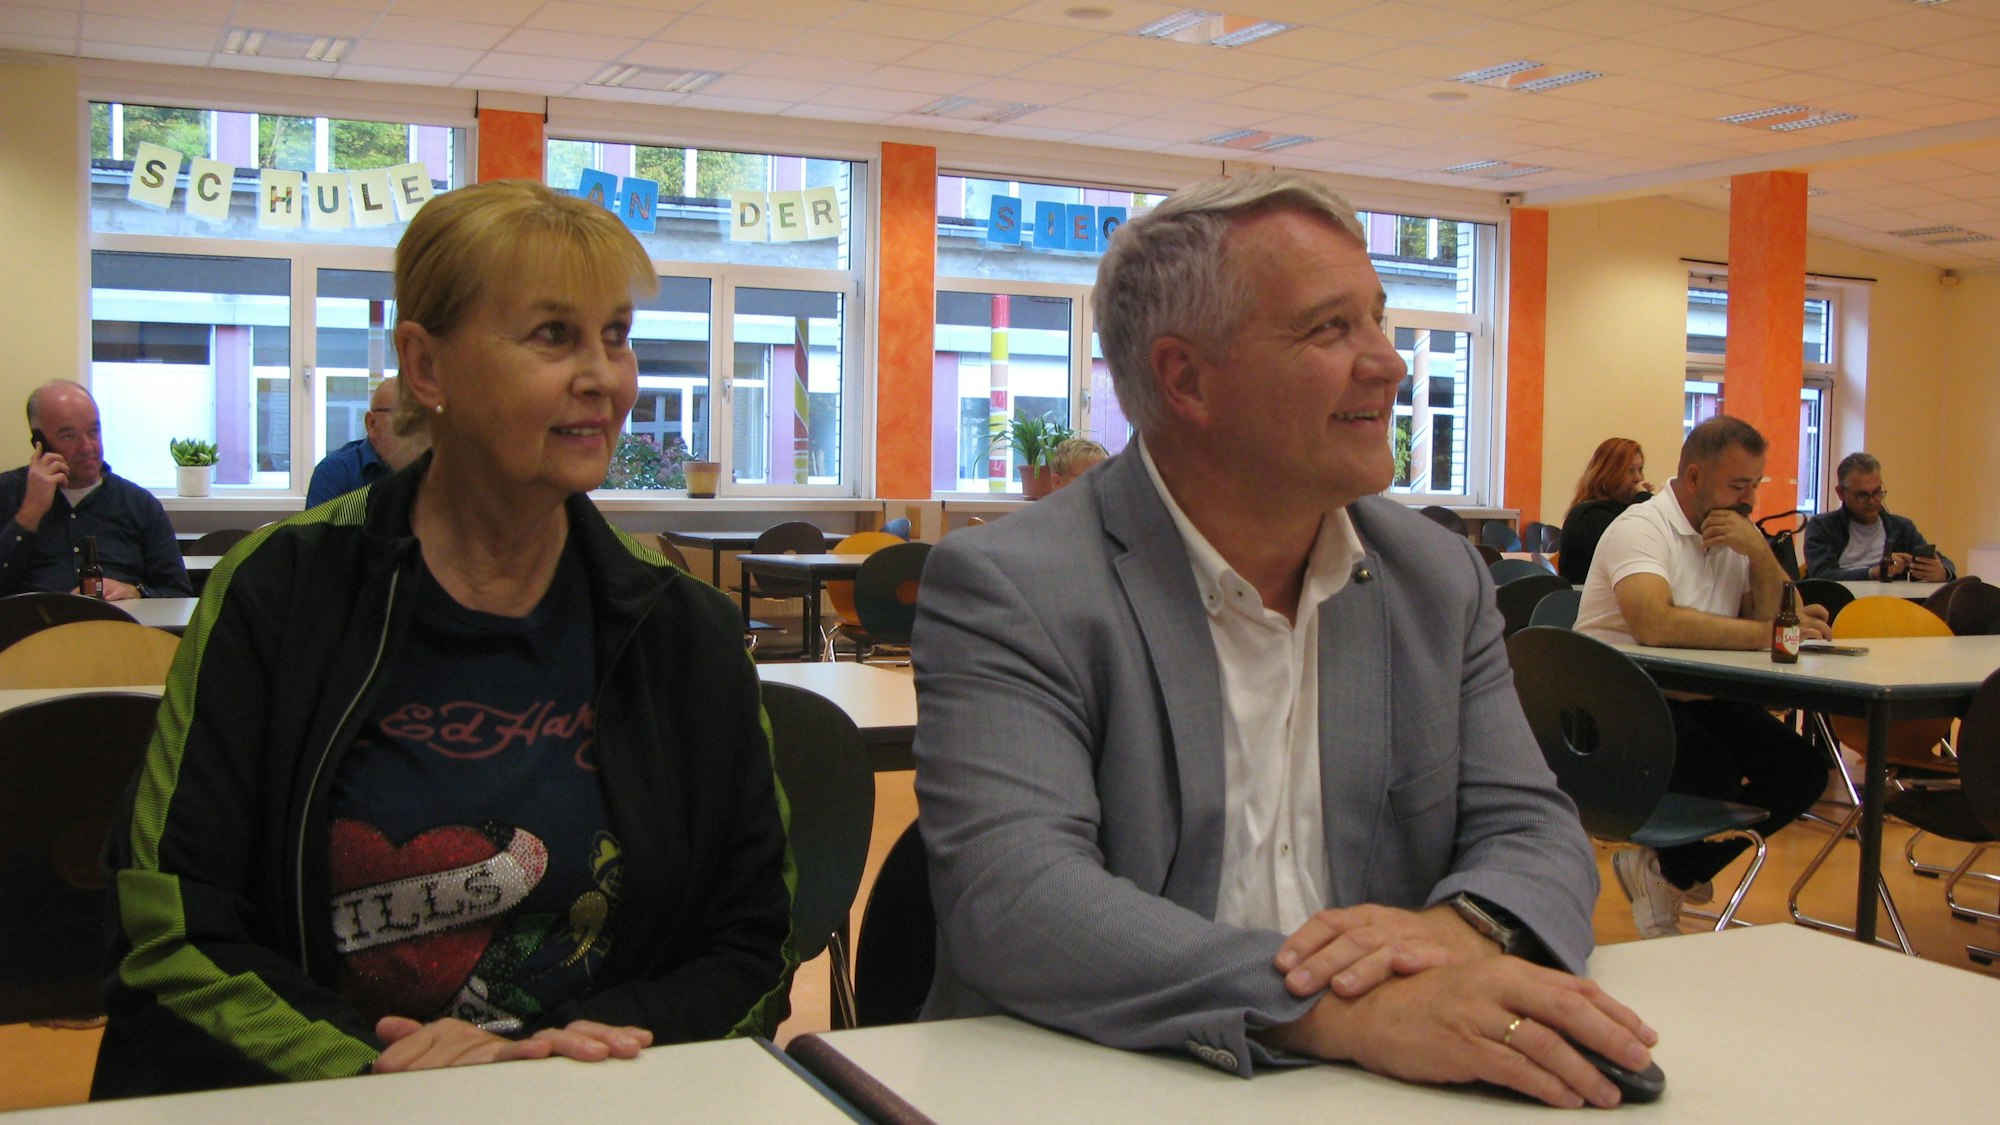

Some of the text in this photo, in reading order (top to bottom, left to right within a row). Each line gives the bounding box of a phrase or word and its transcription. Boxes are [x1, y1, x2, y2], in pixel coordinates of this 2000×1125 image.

[140, 159, 425, 214] SCHULE
[586, 182, 651, 220] AN
[740, 199, 833, 228] DER
[379, 703, 485, 745] Ed
[333, 868, 502, 945] ILLS
